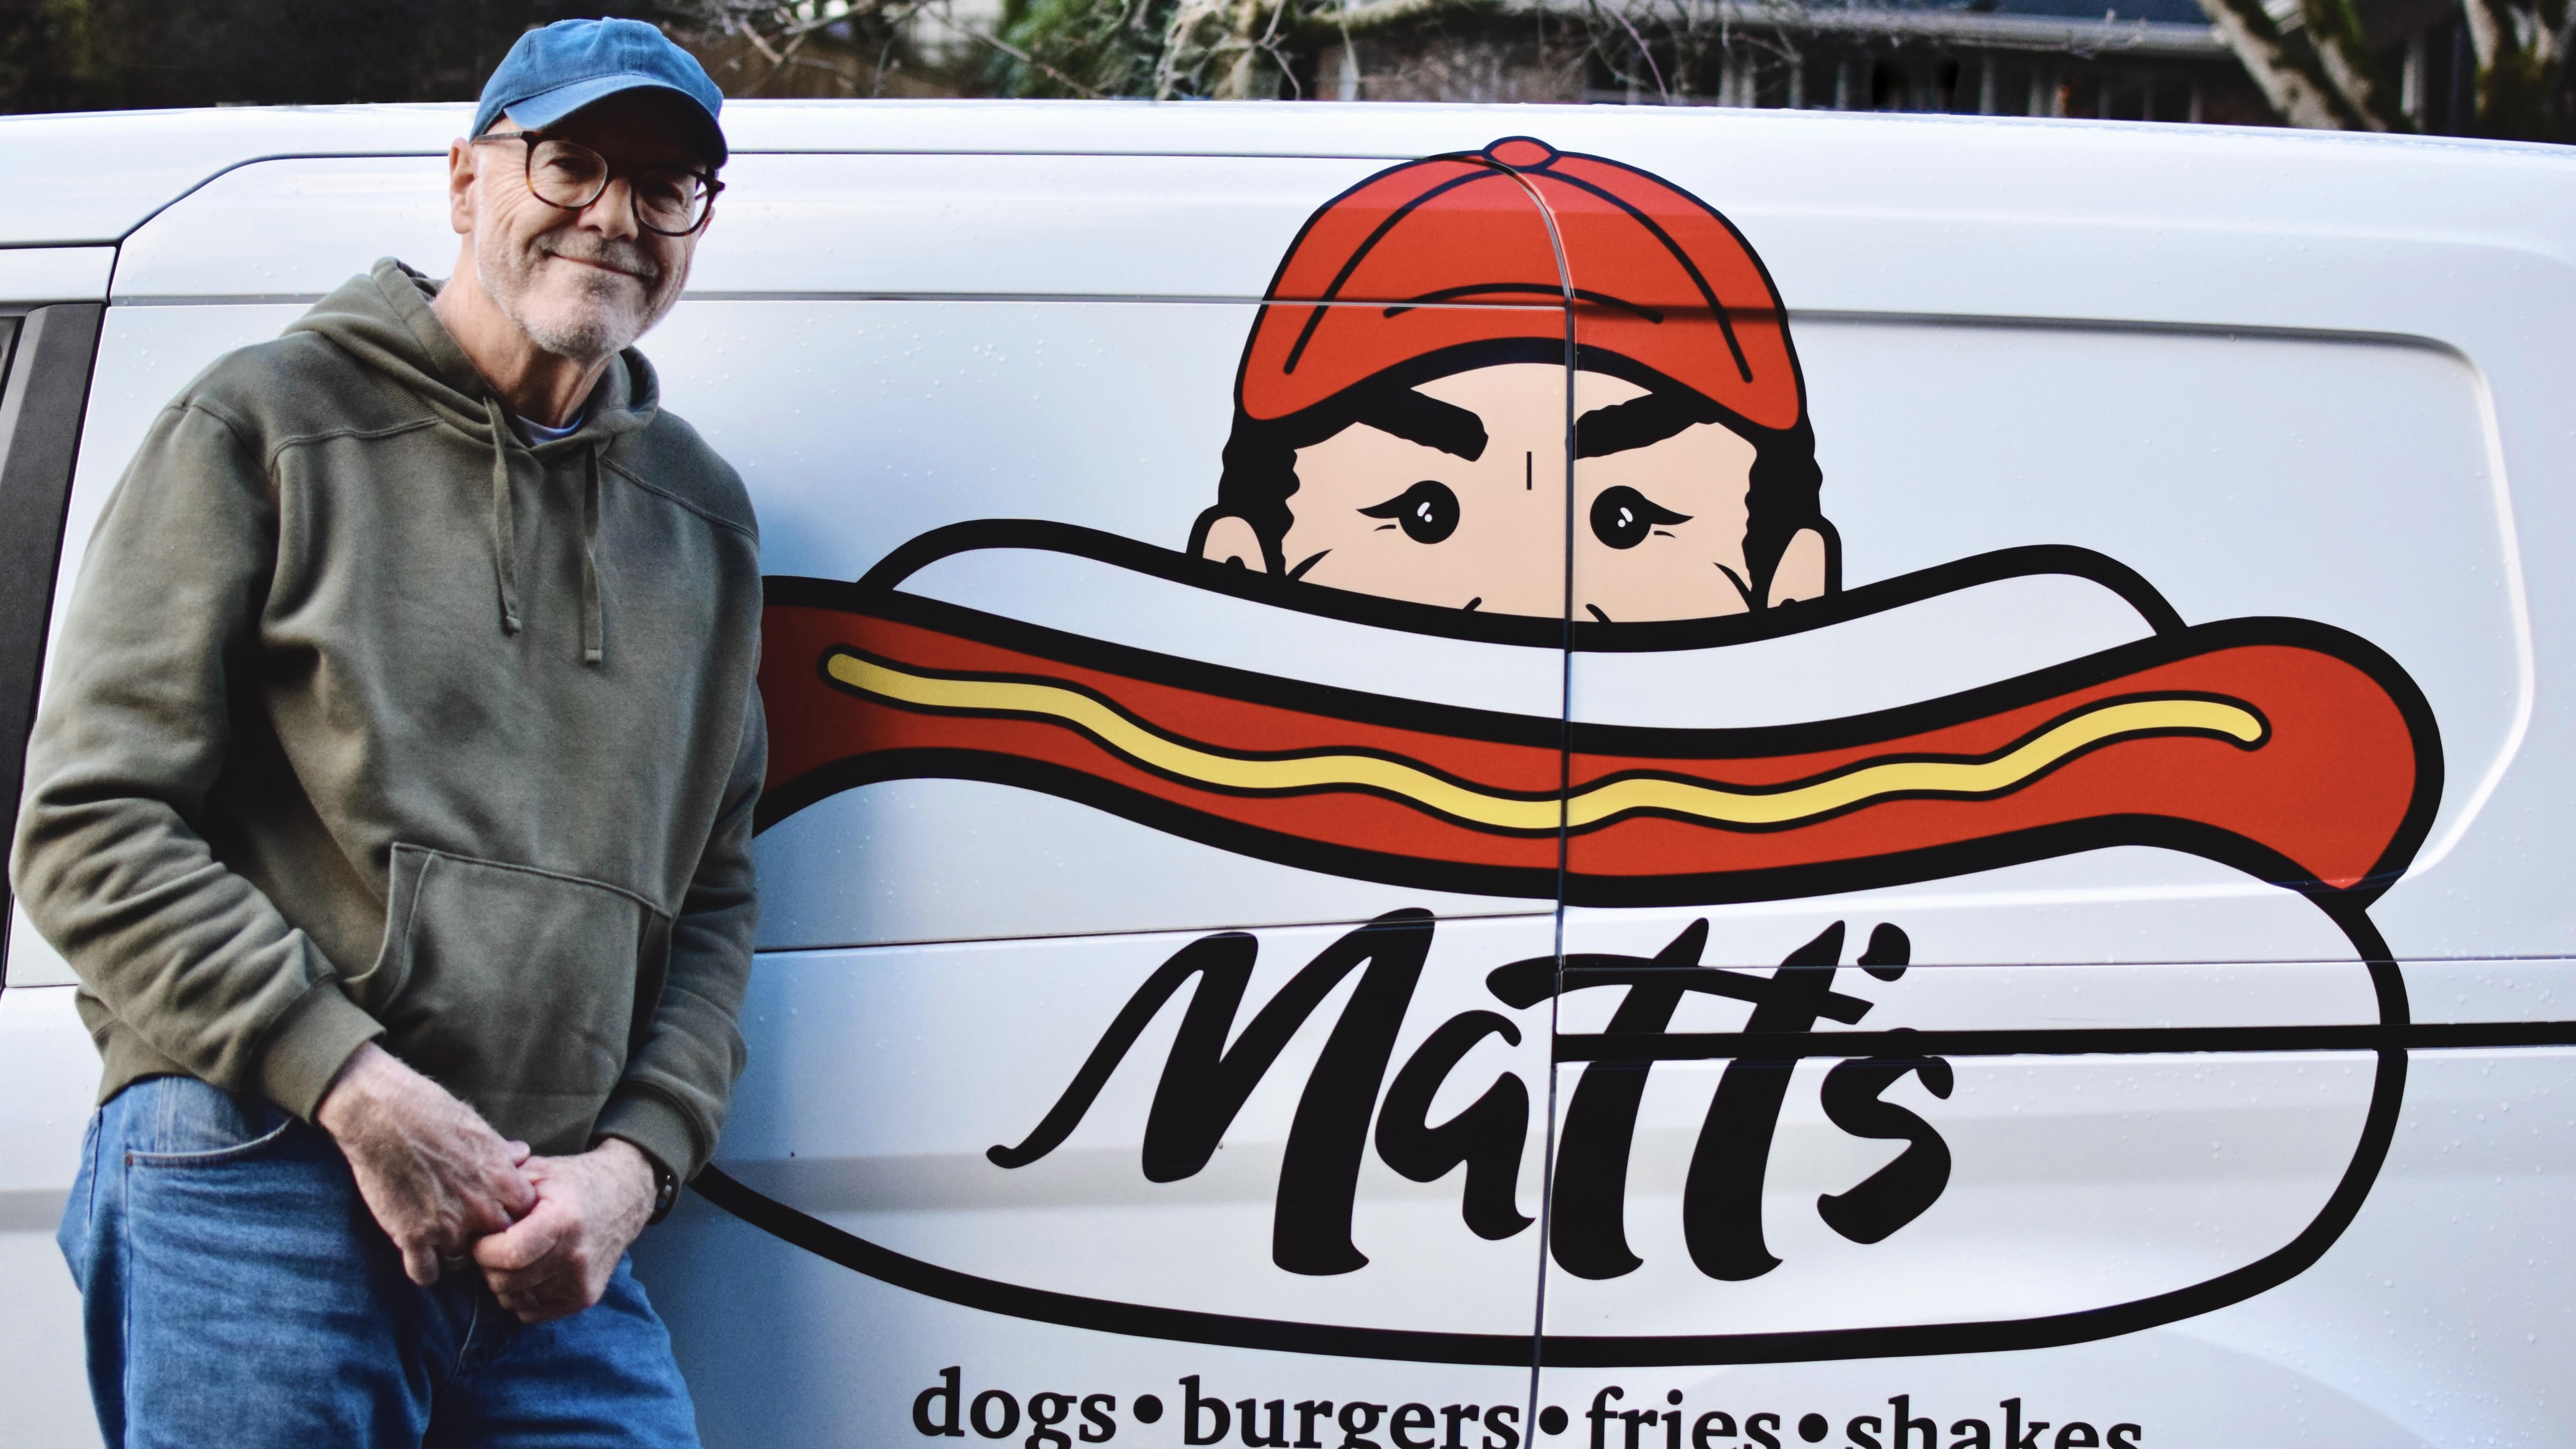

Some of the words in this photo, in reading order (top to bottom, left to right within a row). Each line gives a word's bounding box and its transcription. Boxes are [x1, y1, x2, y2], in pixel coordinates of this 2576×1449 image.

[986, 907, 1954, 1281] Matt's
[912, 1365, 1117, 1449] dogs
[1178, 1375, 1520, 1449] burgers
[1585, 1386, 1781, 1449] fries
